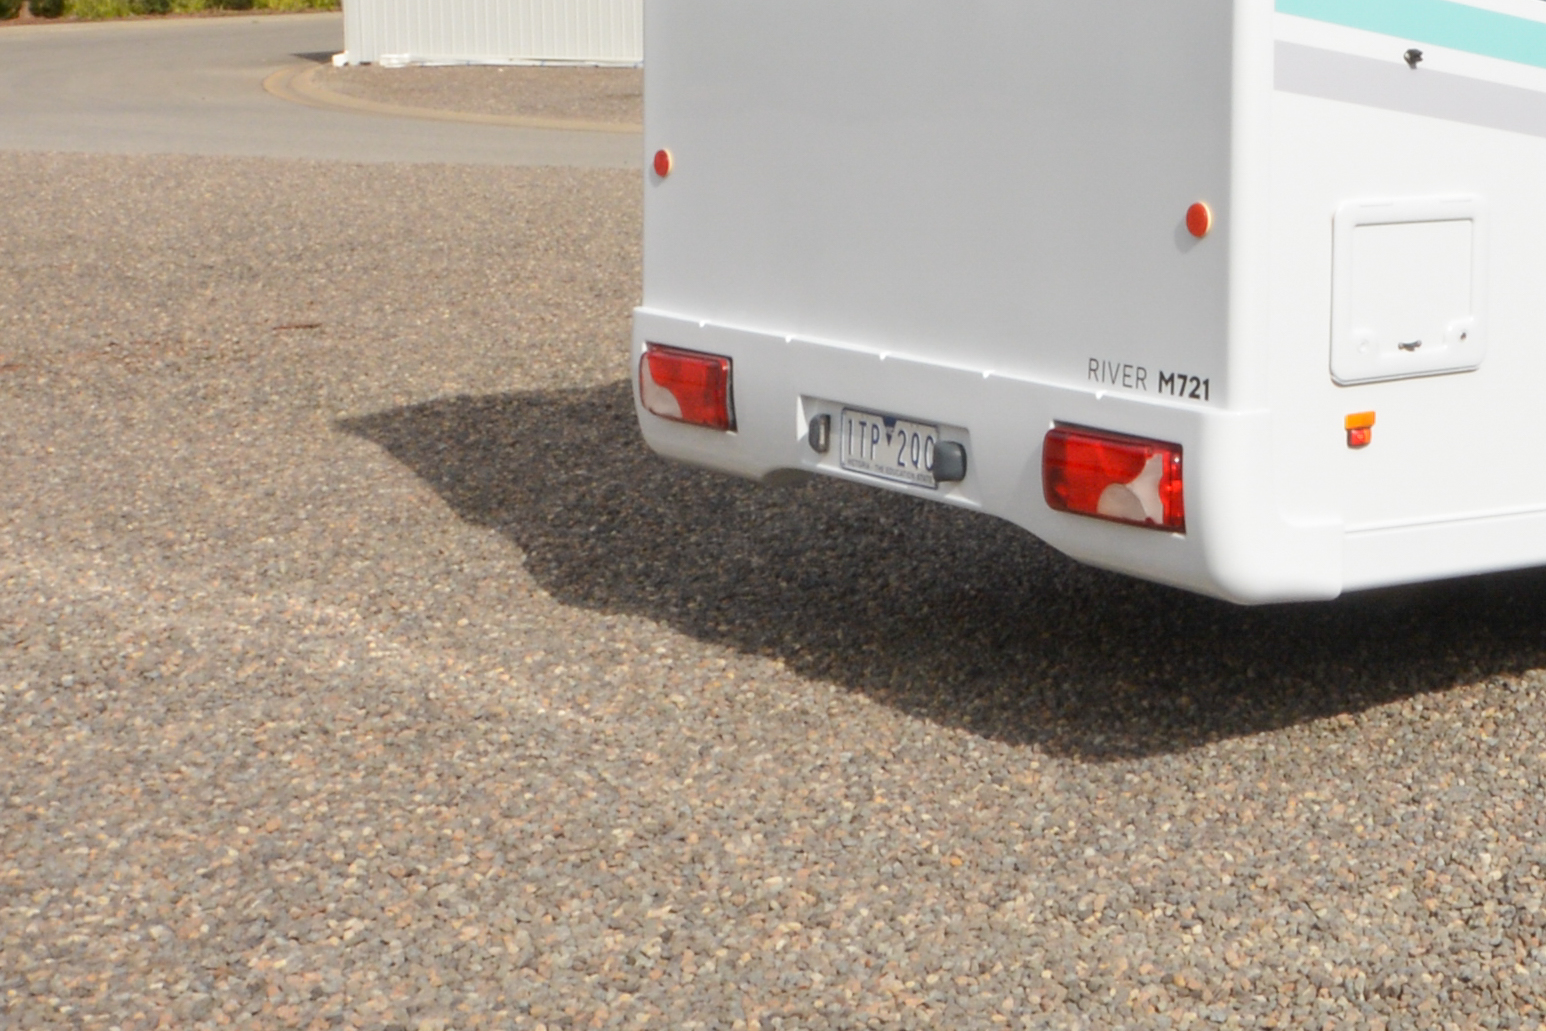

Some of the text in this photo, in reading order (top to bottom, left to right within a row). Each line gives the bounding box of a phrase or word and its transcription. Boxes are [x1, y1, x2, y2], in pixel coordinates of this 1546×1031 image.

[1088, 357, 1210, 401] RIVER M721
[849, 419, 881, 461] 1TP
